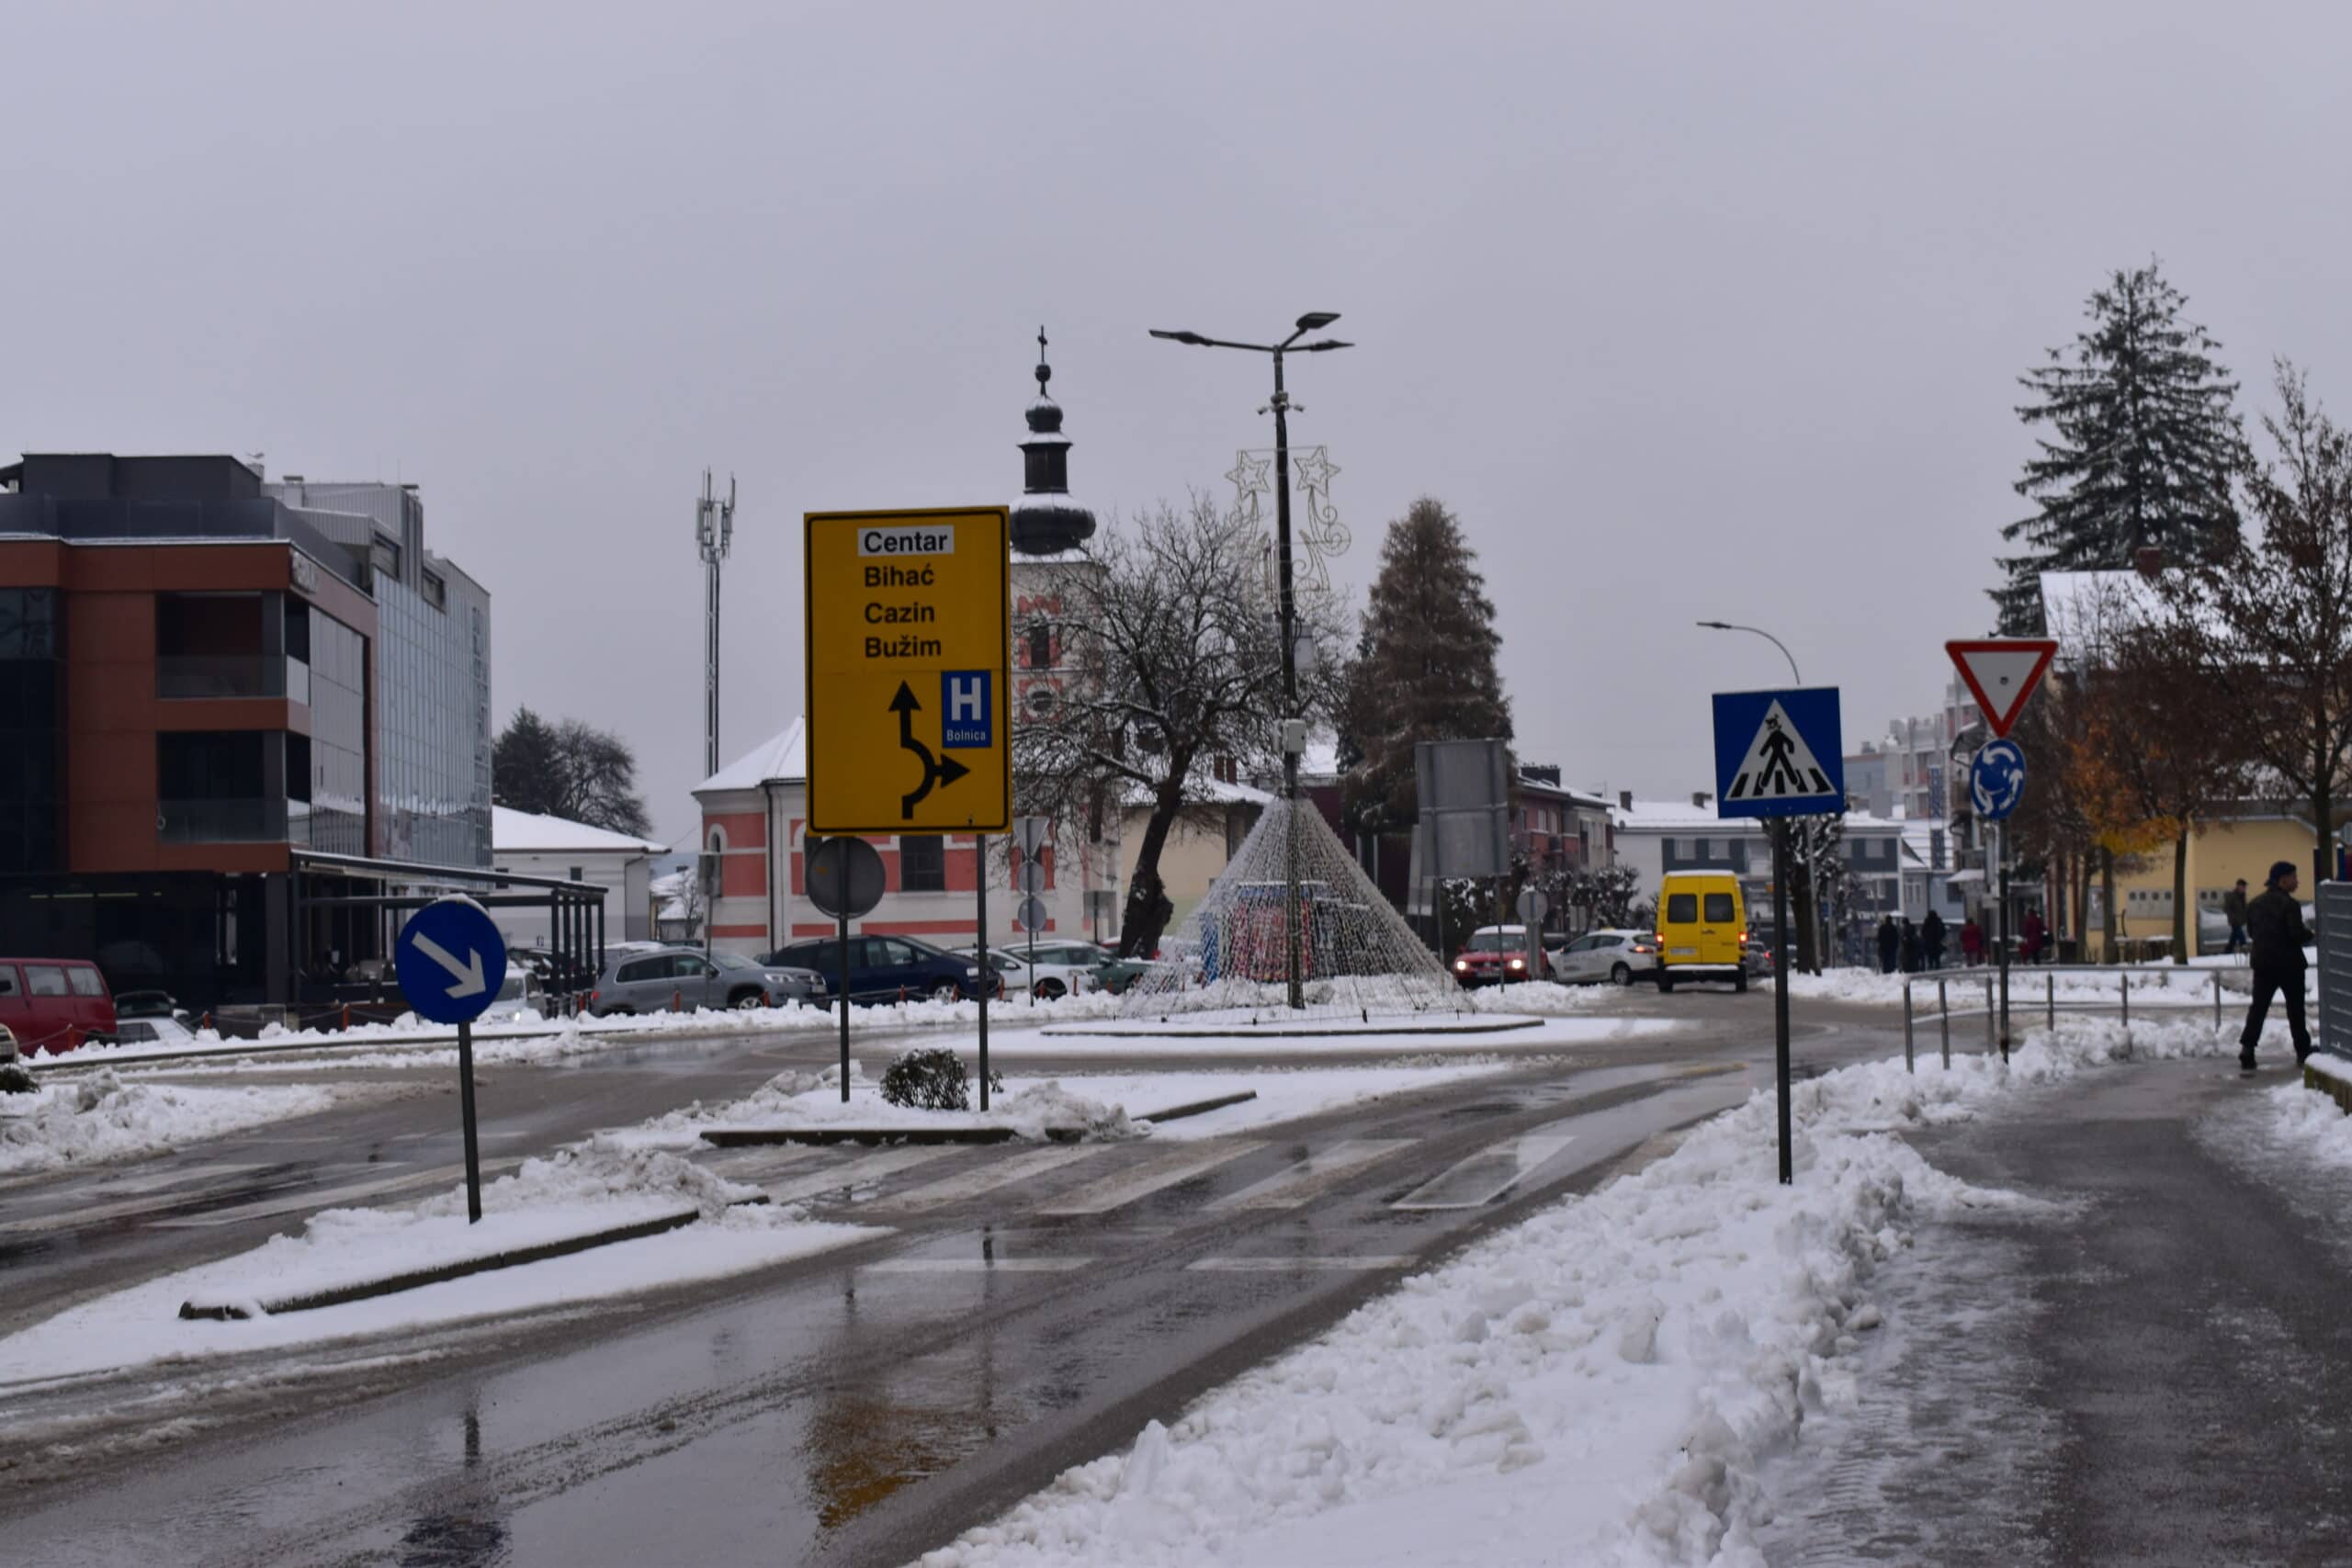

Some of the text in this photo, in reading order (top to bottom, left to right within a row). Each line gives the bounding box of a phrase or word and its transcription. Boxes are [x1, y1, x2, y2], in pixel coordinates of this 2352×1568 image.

[864, 531, 948, 553] Centar
[864, 563, 934, 587] Bihać
[864, 602, 935, 624] Cazin
[865, 635, 942, 659] Bužim
[950, 677, 981, 721] H
[946, 728, 987, 741] Bolnica
